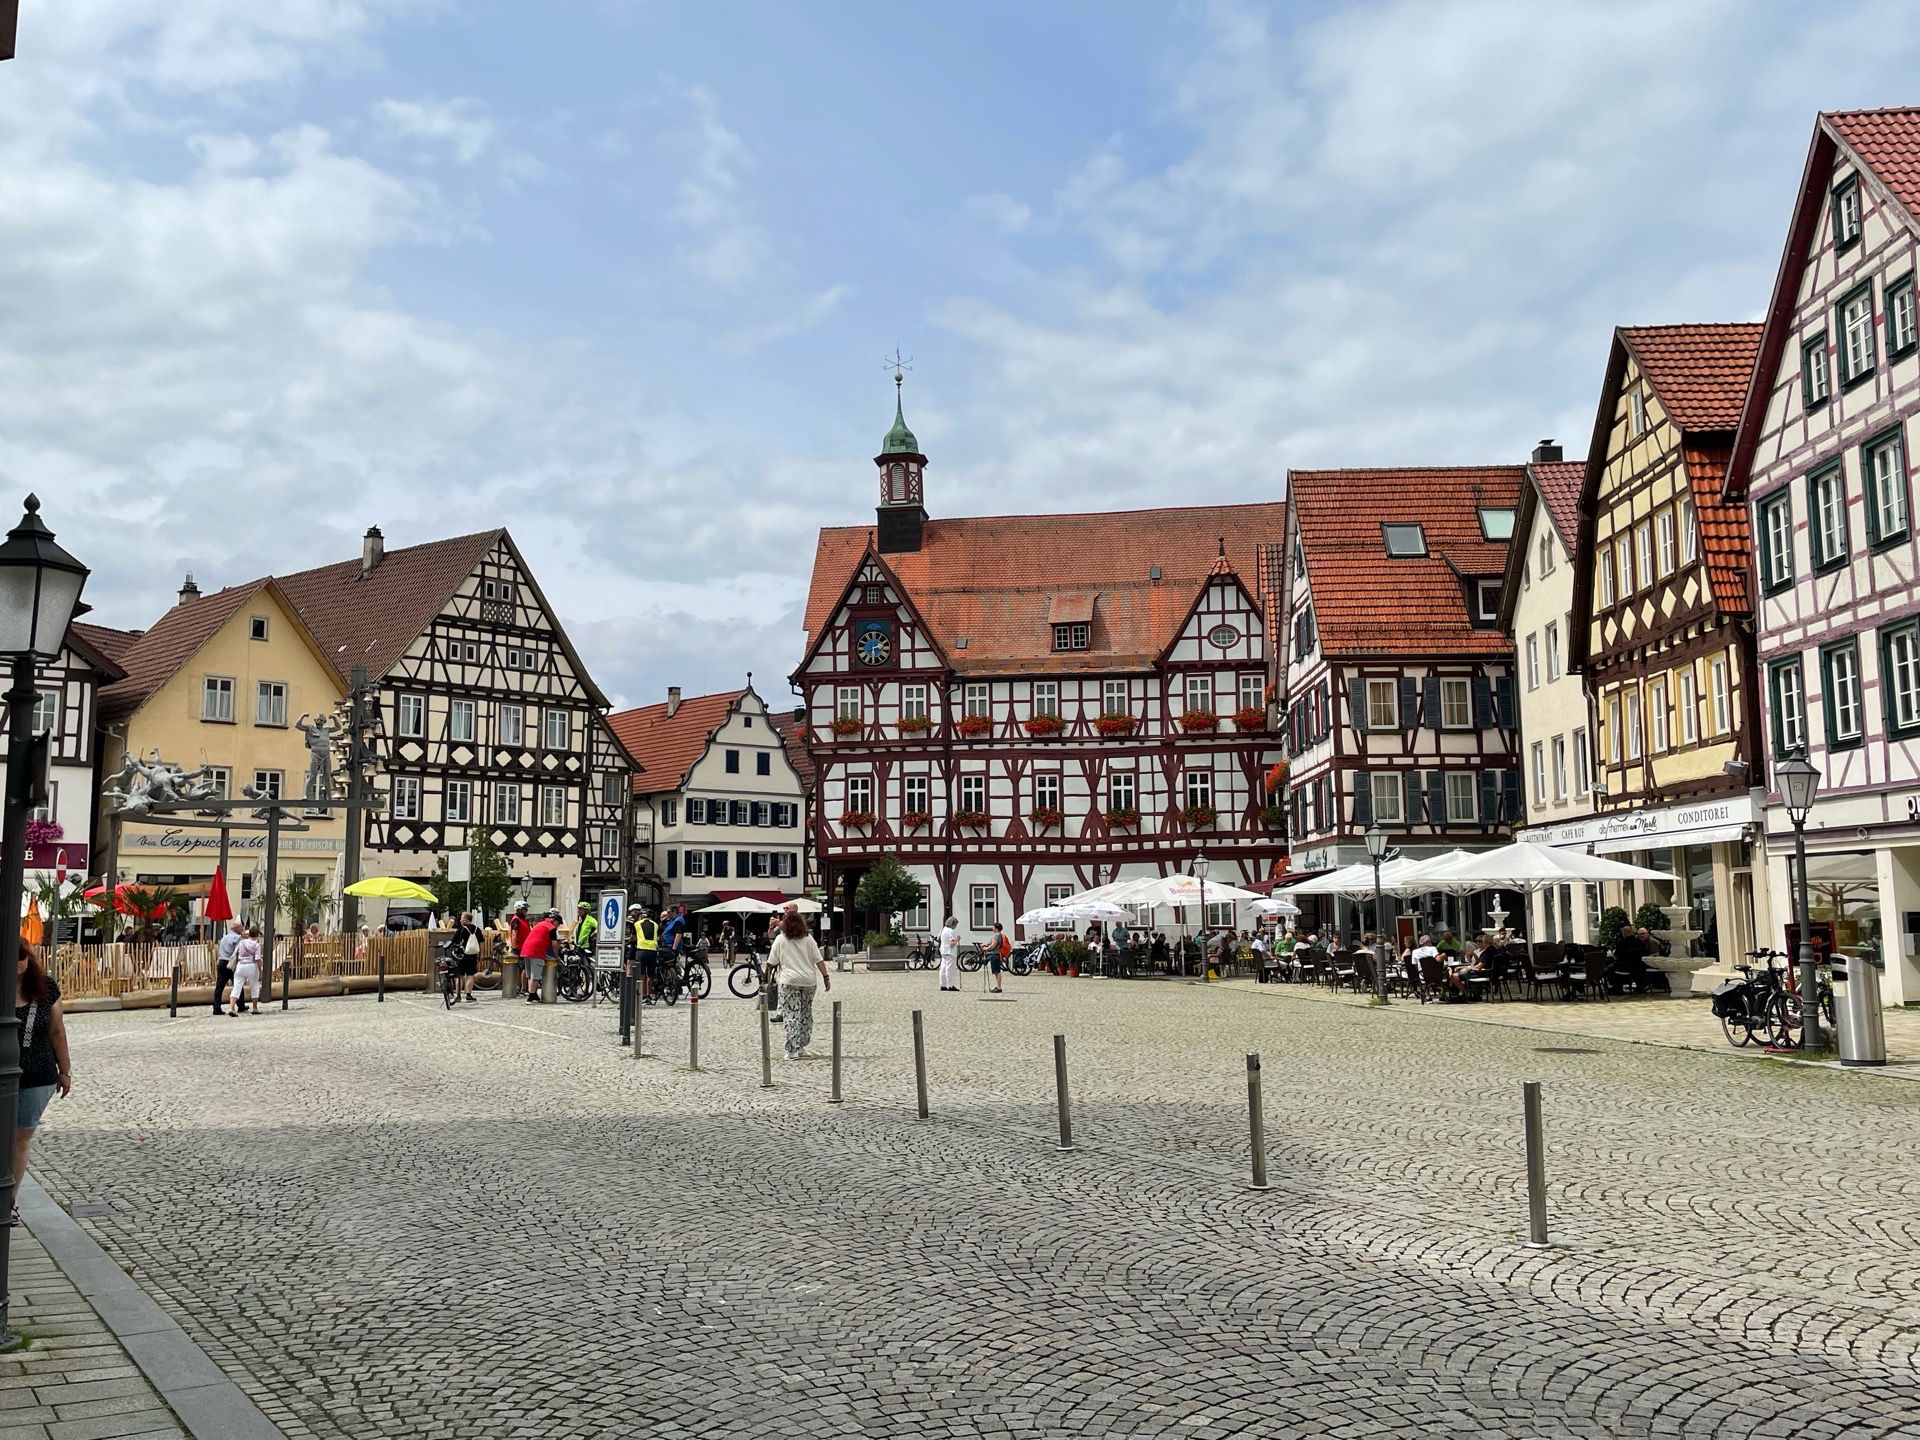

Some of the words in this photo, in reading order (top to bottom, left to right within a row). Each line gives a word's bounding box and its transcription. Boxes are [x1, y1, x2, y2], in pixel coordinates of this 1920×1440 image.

[1677, 806, 1729, 825] CONDITOREI
[160, 828, 245, 853] Cappuccni
[248, 835, 268, 848] 66
